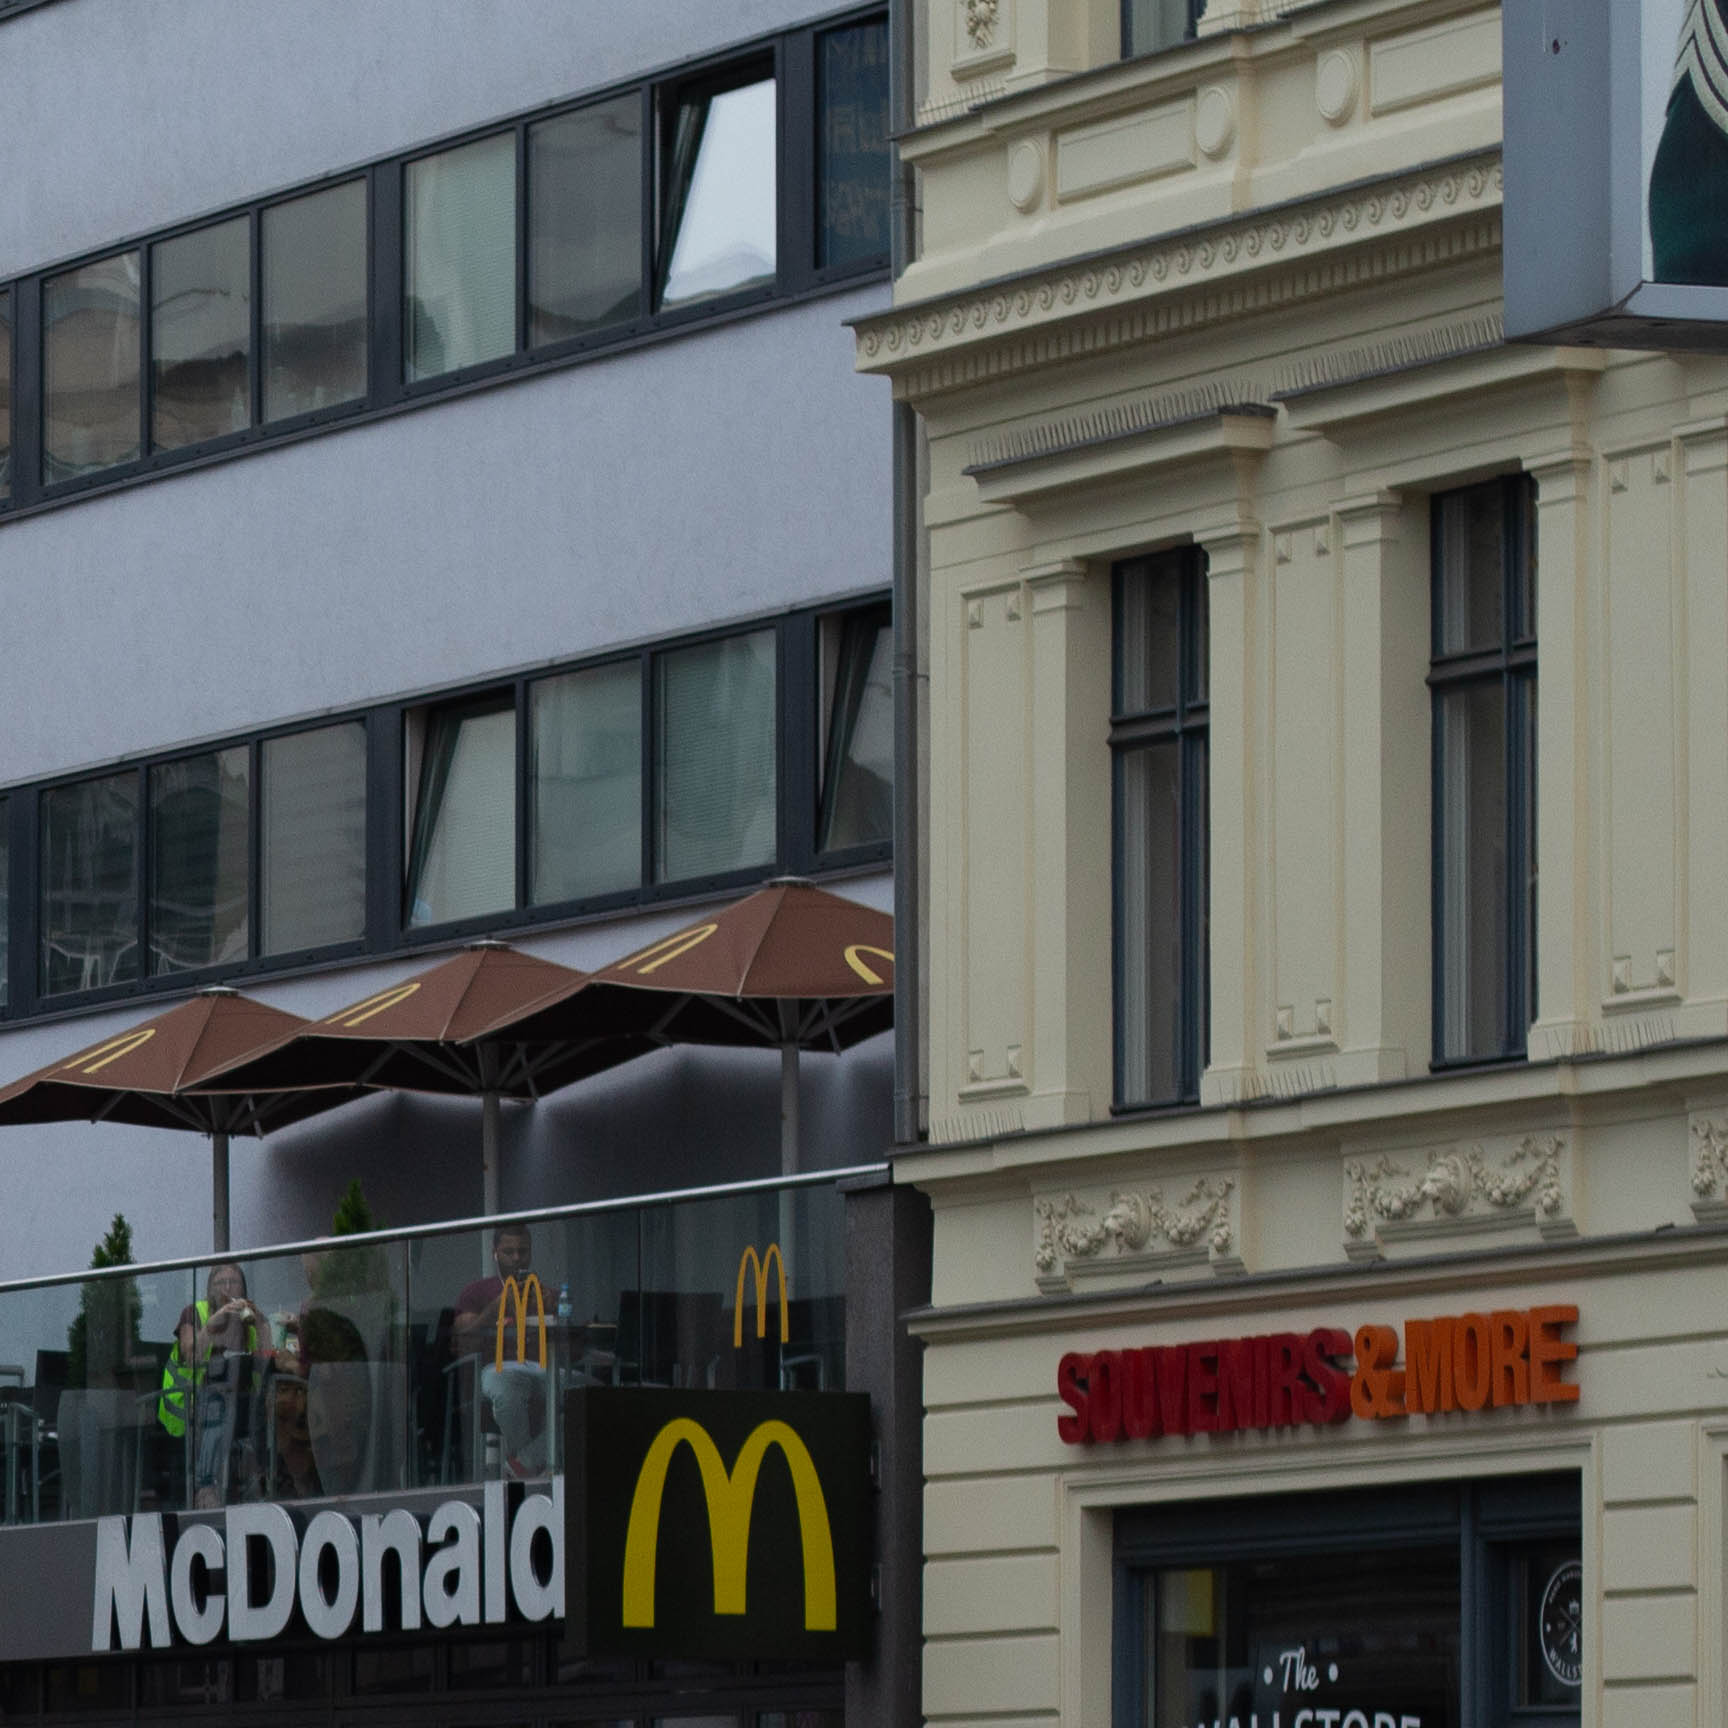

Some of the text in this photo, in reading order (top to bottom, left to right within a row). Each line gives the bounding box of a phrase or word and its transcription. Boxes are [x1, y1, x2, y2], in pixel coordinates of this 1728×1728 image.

[1057, 1304, 1580, 1445] SOUVENIRS & MORE
[1279, 1646, 1320, 1693] The
